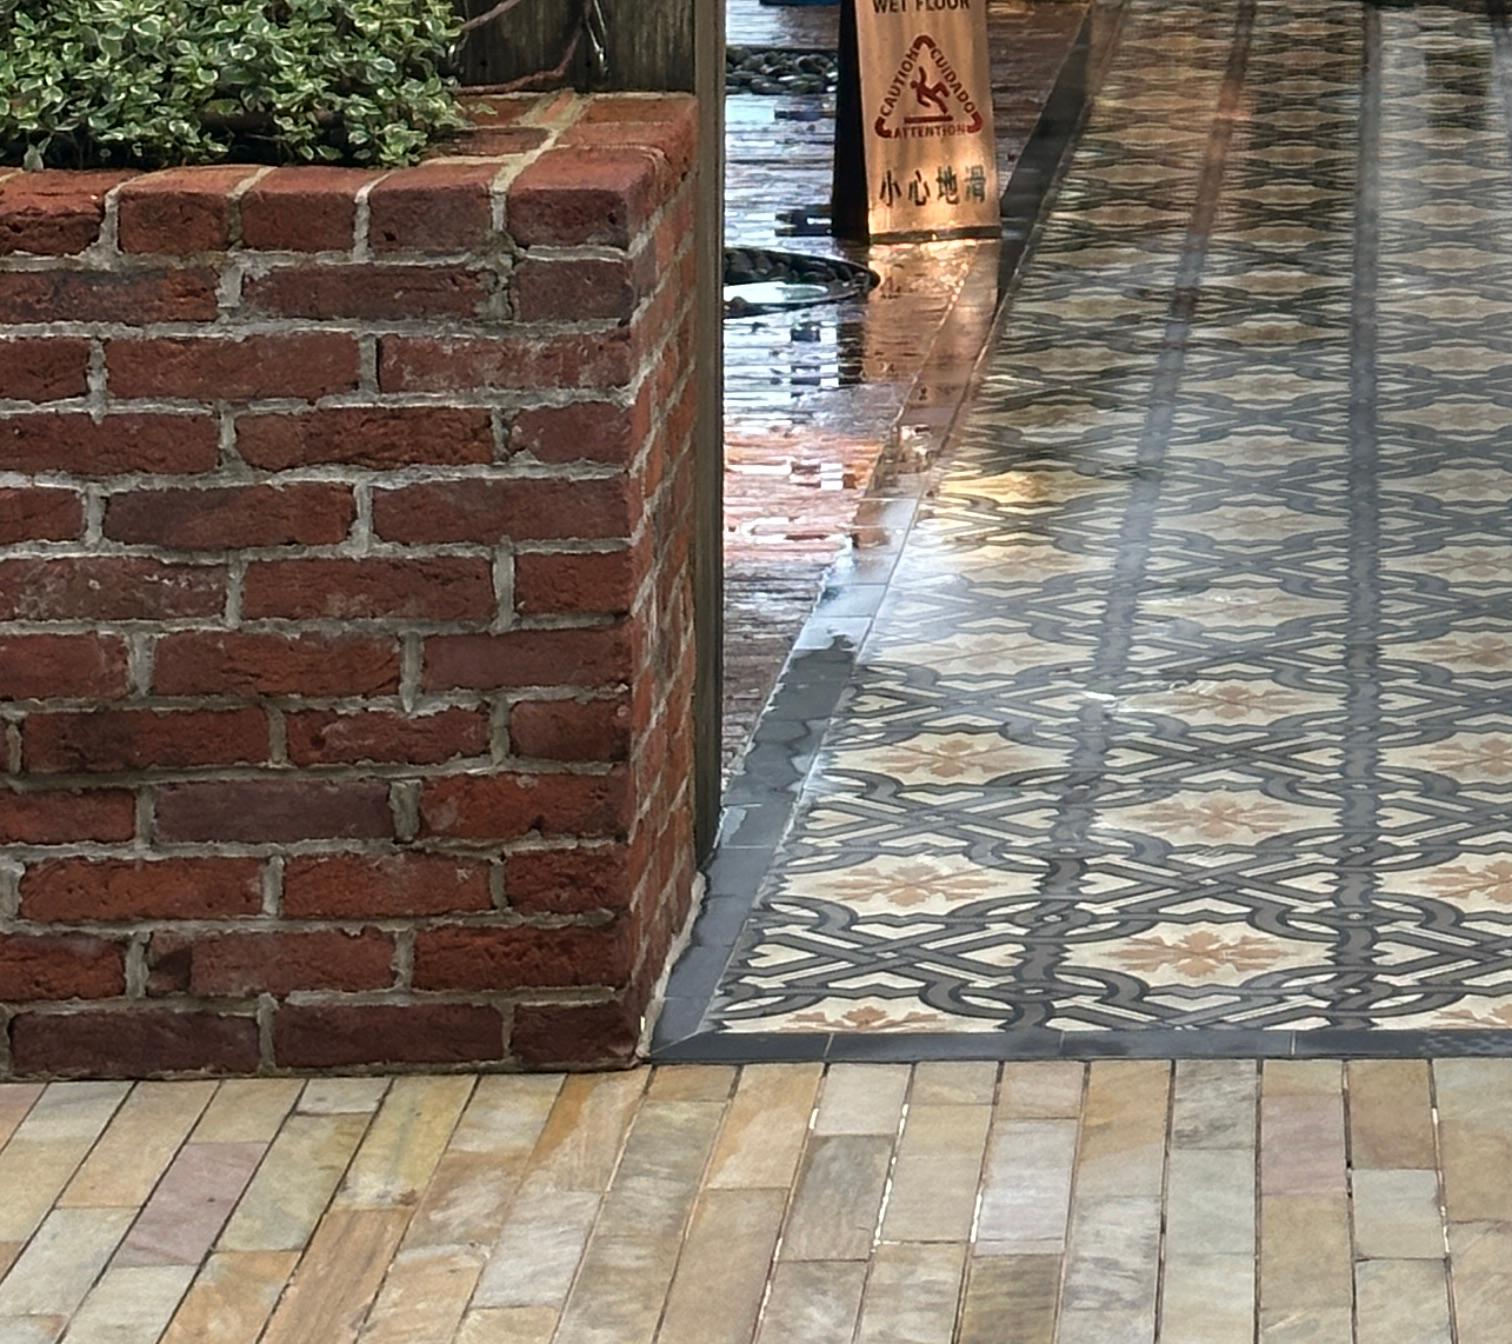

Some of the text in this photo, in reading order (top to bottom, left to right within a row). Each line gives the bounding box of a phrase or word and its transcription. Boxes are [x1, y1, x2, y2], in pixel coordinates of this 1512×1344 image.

[880, 46, 920, 118] CAUTION
[930, 48, 976, 115] CUIDADO
[891, 124, 969, 140] ATTENTION
[878, 163, 988, 208] 小心地滑
